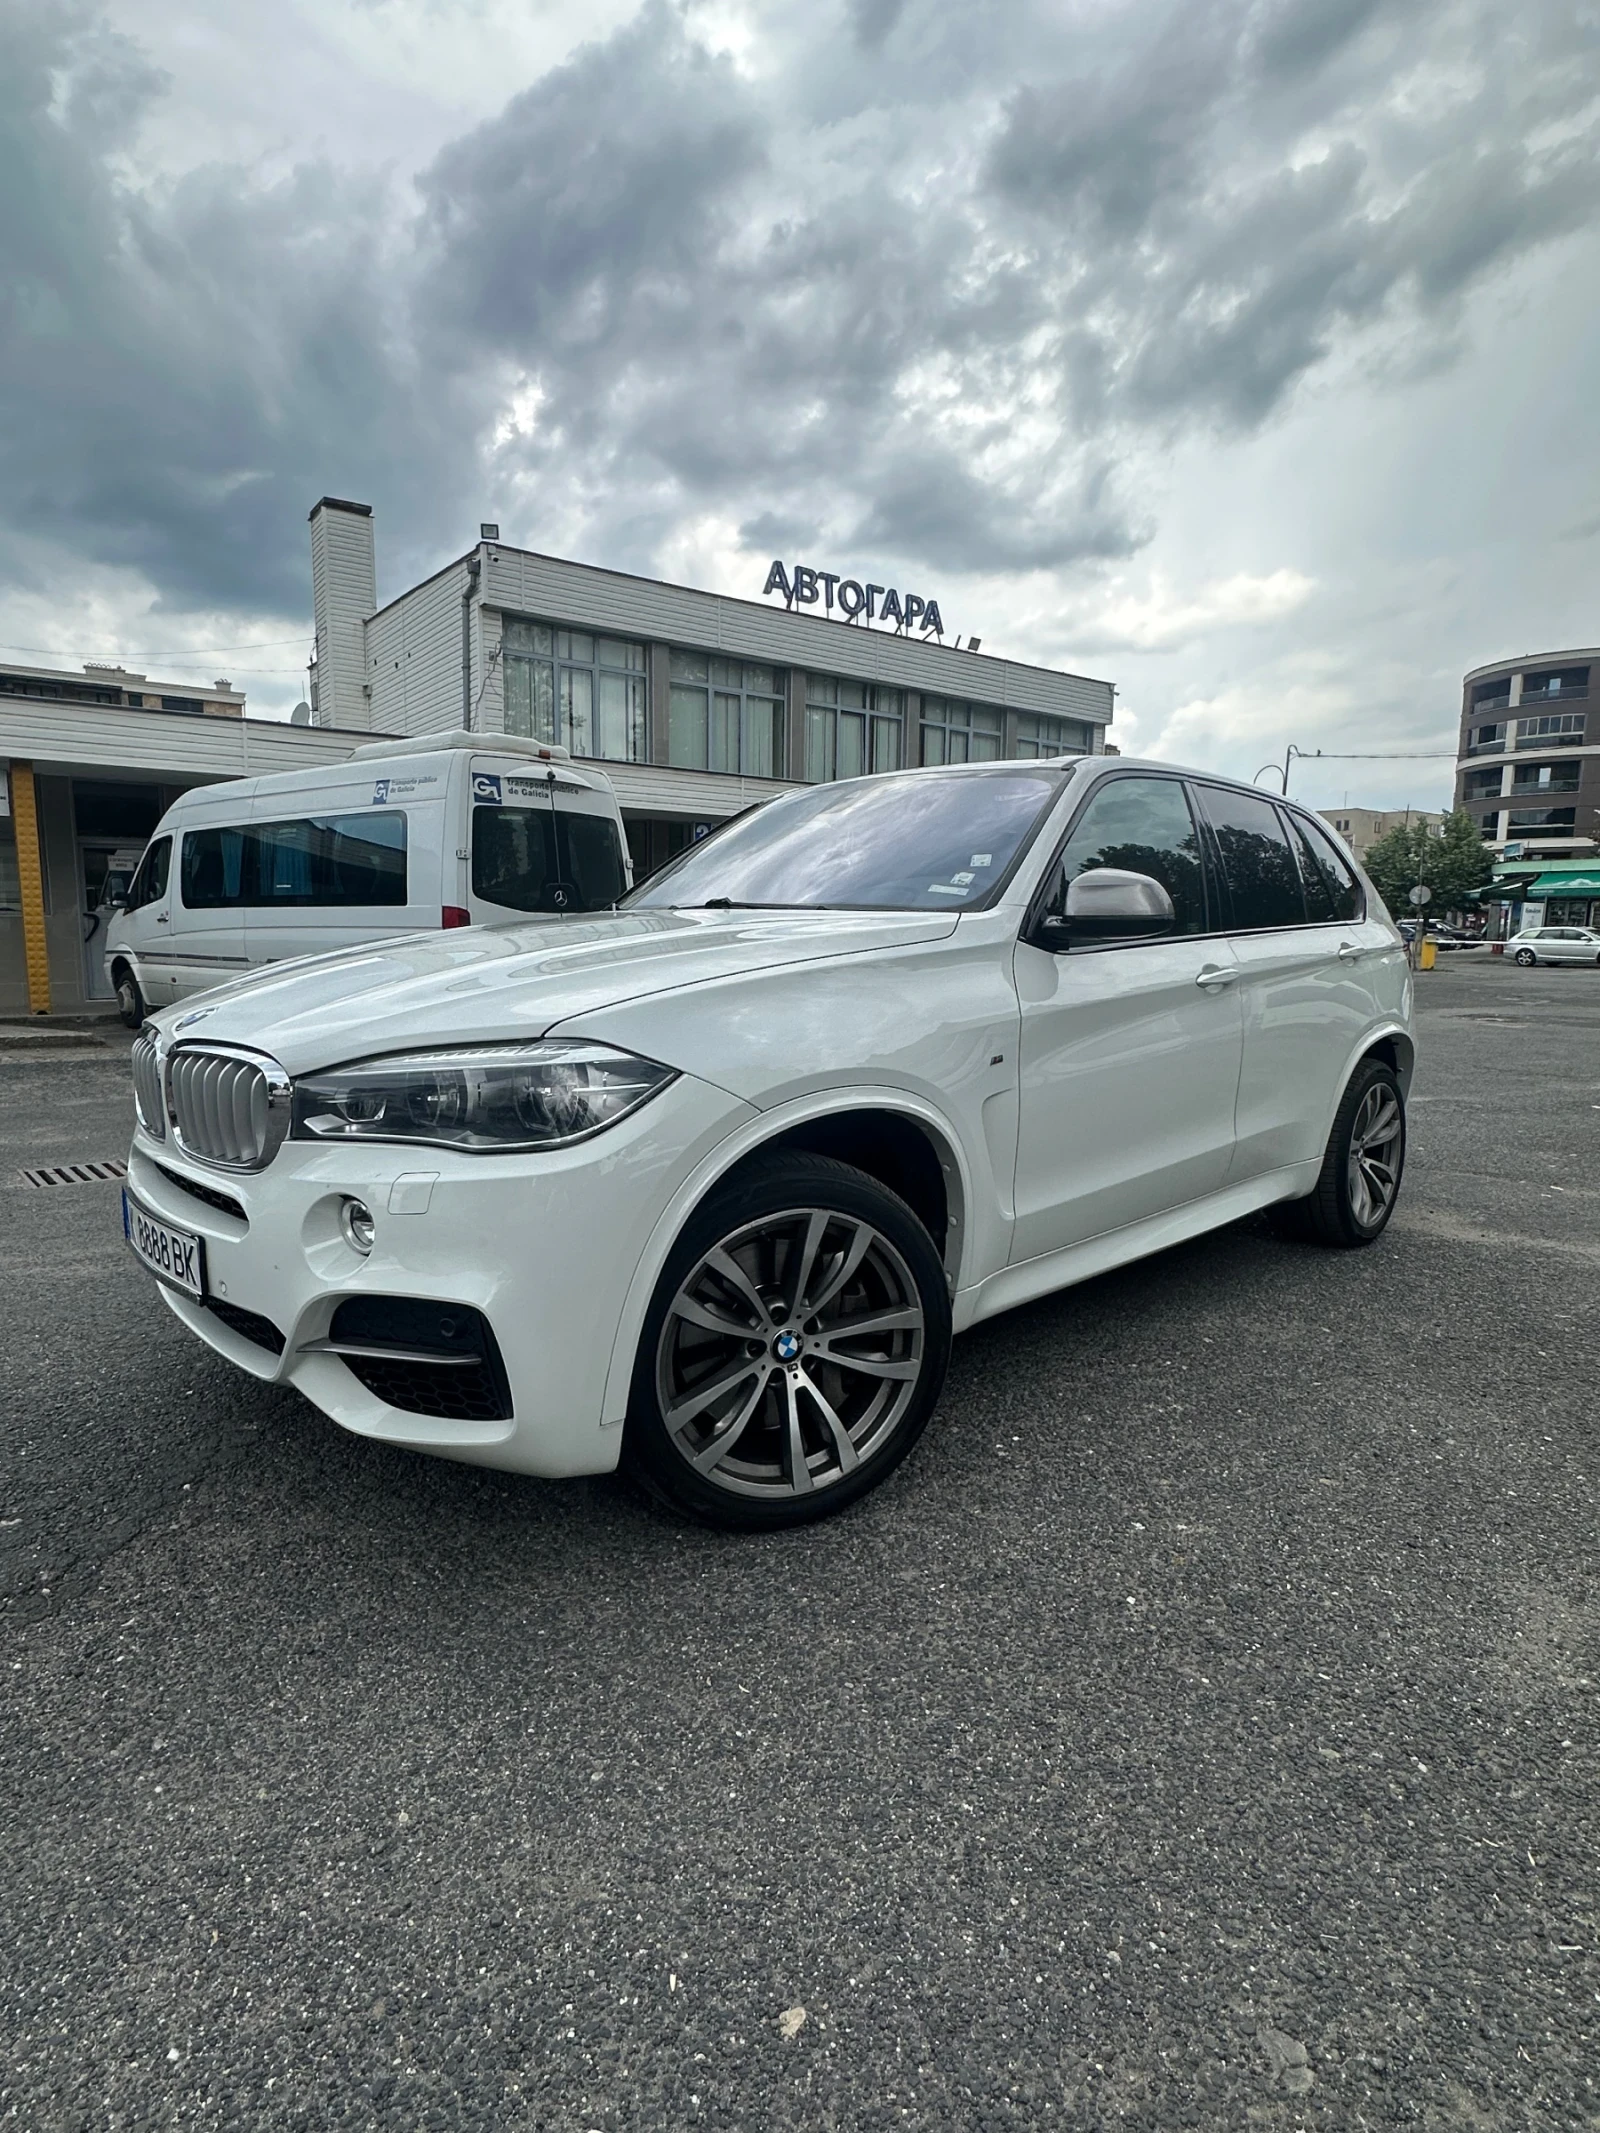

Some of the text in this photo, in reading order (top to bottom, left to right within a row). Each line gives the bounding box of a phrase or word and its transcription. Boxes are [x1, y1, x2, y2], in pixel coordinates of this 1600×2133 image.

[762, 560, 944, 635] АВТОГАРА
[507, 778, 549, 790] transporte
[508, 787, 549, 798] de Galicia
